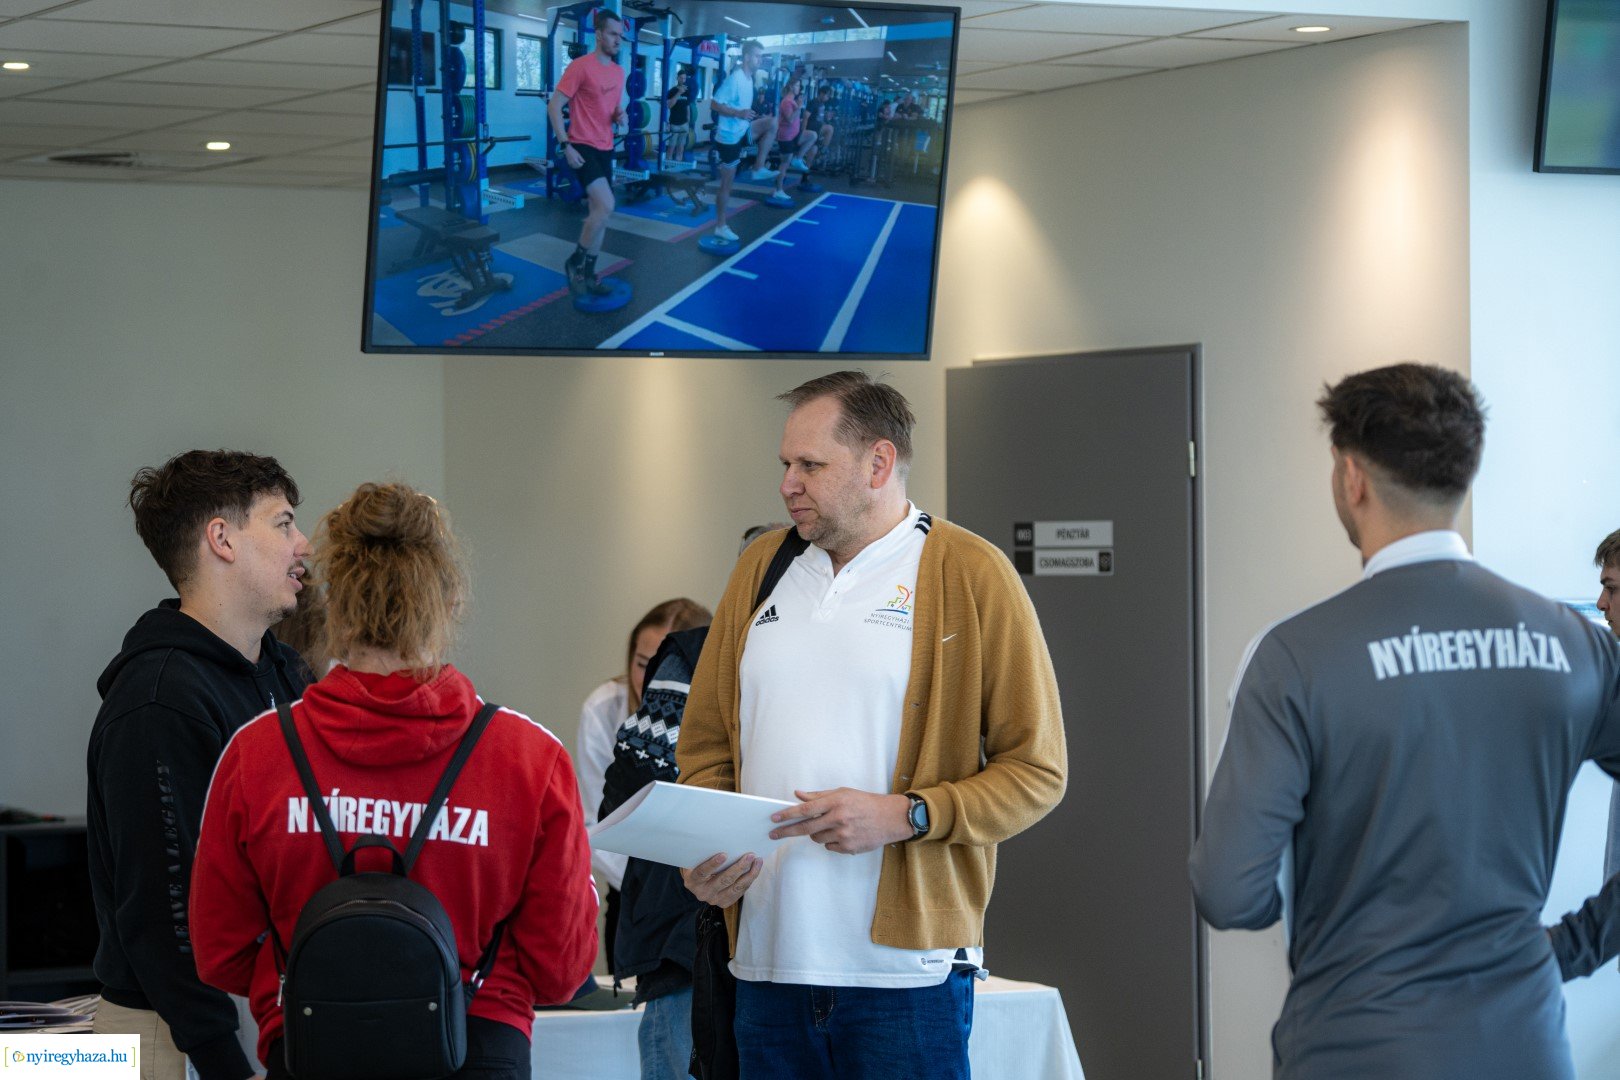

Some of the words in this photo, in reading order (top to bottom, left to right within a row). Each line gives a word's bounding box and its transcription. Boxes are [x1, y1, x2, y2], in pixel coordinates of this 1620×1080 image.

[755, 615, 780, 627] adidas
[863, 618, 912, 632] SPORTCENTRUM
[1367, 622, 1572, 681] NYÍREGYHÁZA
